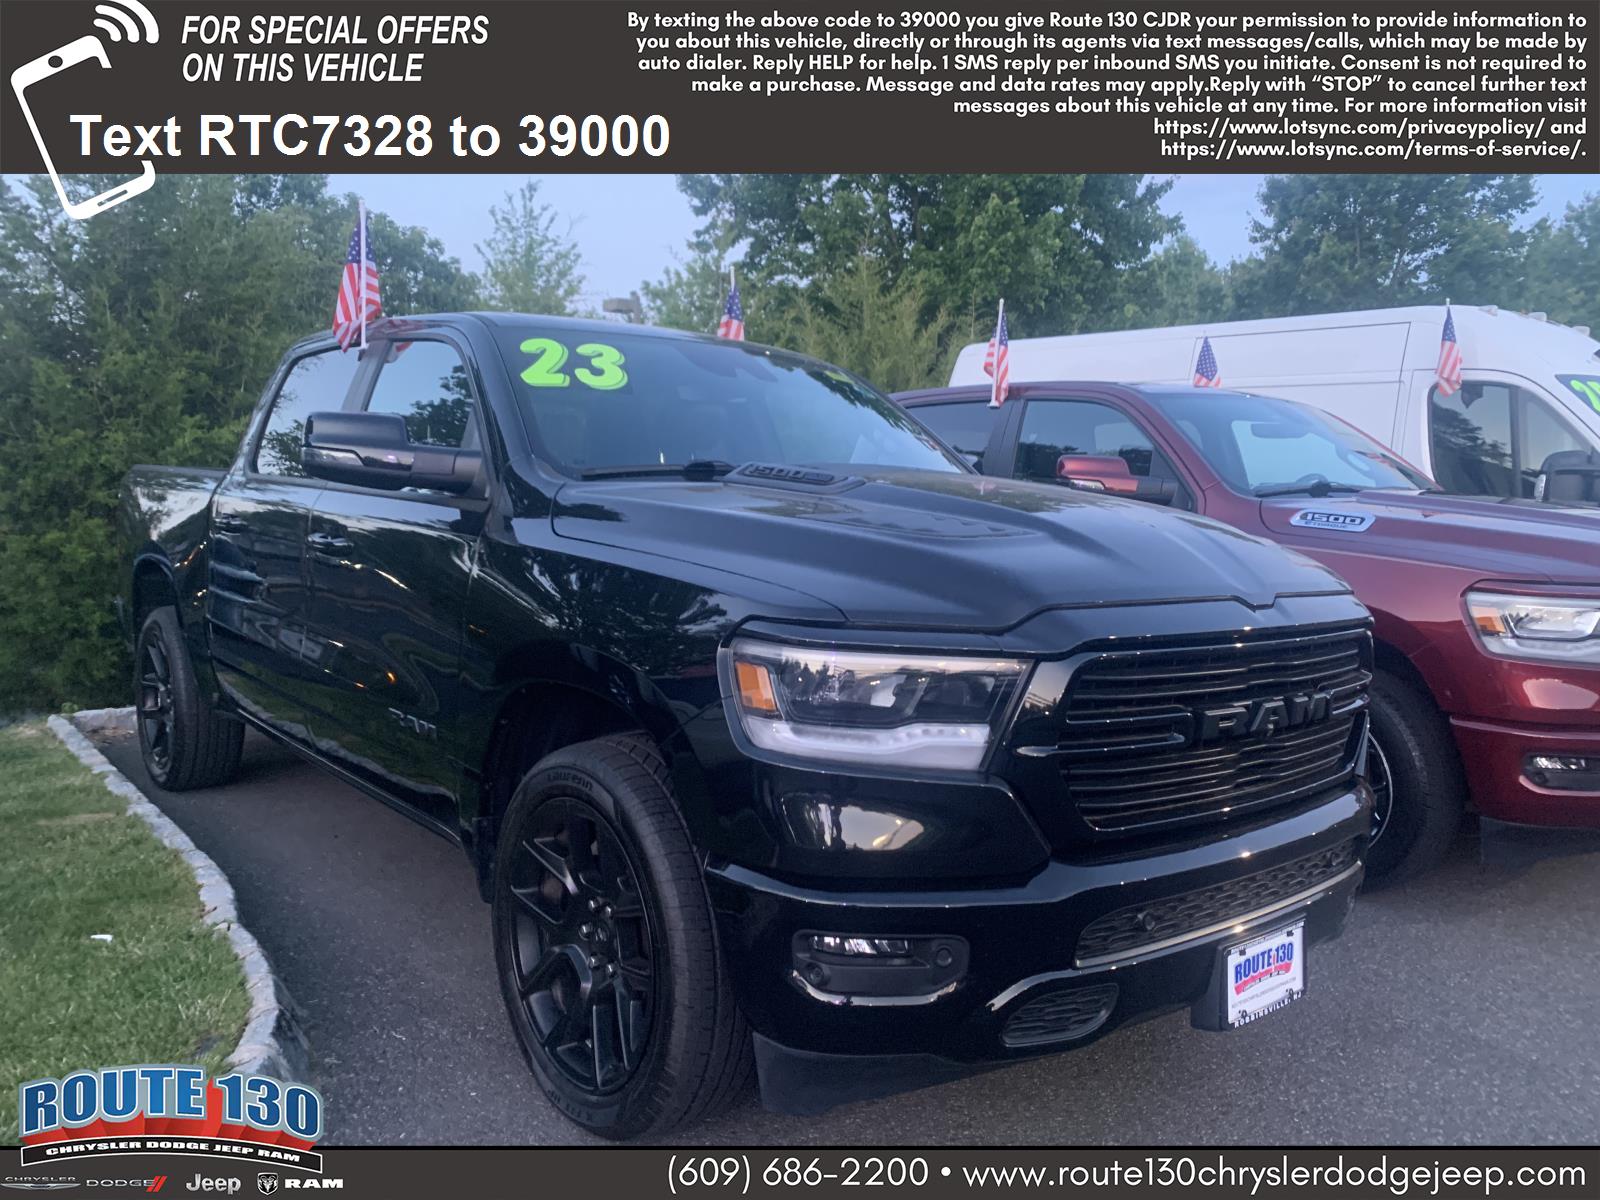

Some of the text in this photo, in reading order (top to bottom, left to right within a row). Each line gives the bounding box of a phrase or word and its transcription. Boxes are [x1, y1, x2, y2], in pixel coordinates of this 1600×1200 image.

[519, 337, 629, 390] 23
[1306, 512, 1362, 526] 1500
[1202, 691, 1331, 739] RAM
[1233, 947, 1273, 985] ROUTE
[1274, 942, 1295, 966] 130
